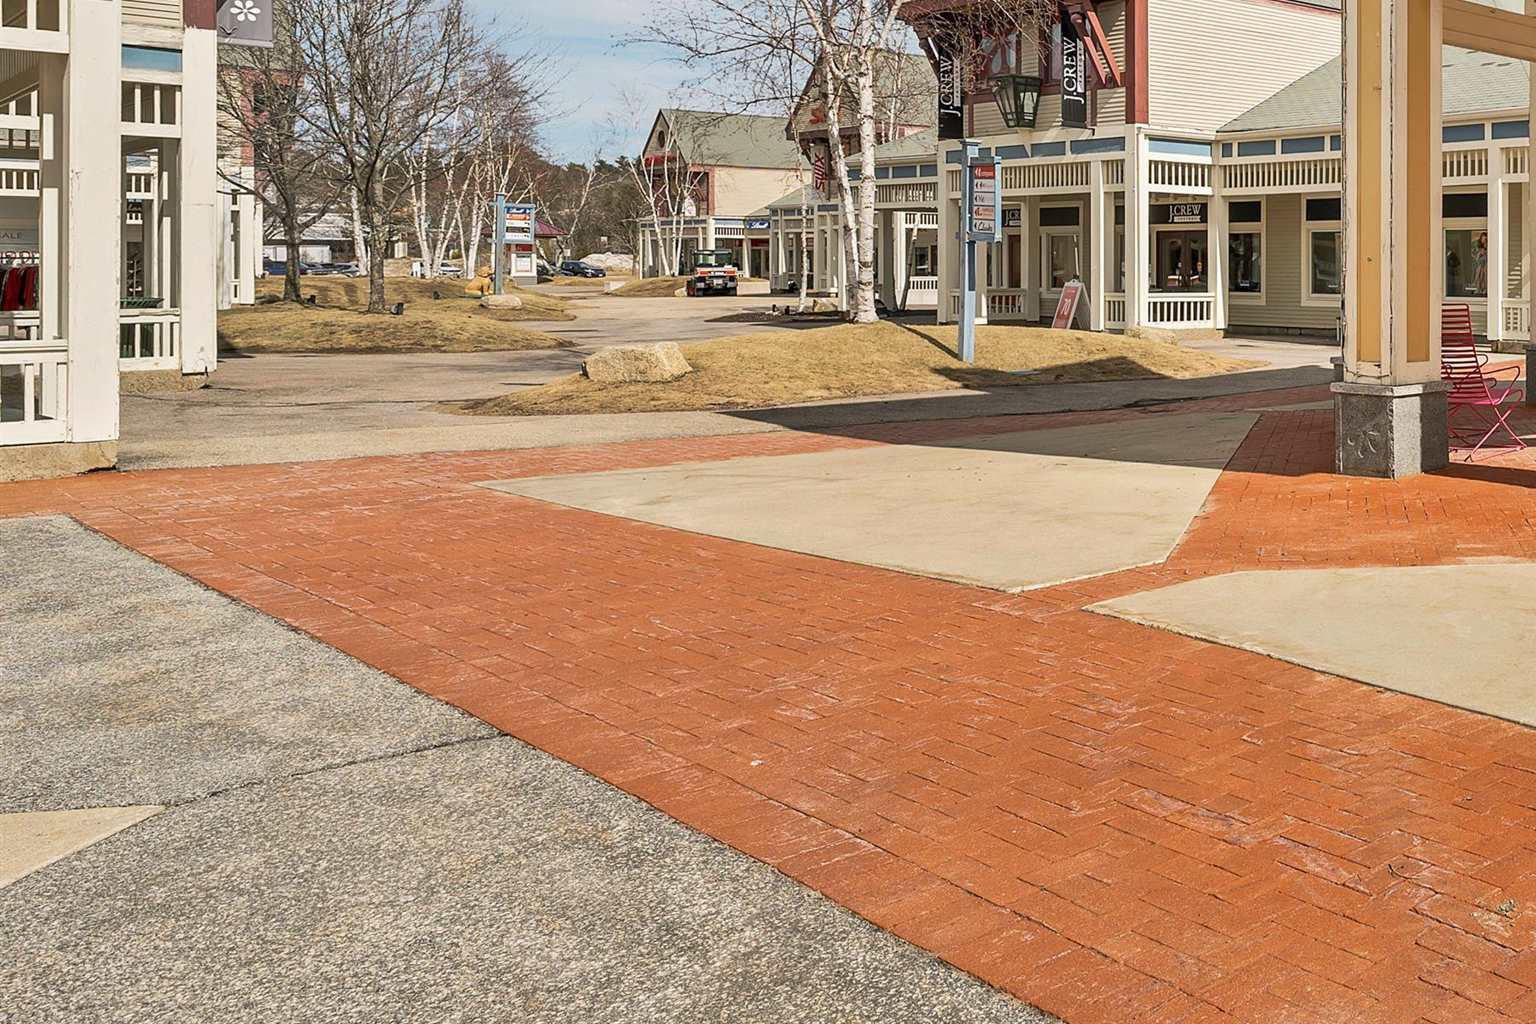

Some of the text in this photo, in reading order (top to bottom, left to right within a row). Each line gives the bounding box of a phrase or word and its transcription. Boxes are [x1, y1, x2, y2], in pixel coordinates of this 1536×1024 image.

[940, 56, 961, 117] J.CREW
[1063, 37, 1085, 104] J.CREW
[1168, 204, 1201, 223] J.CREW
